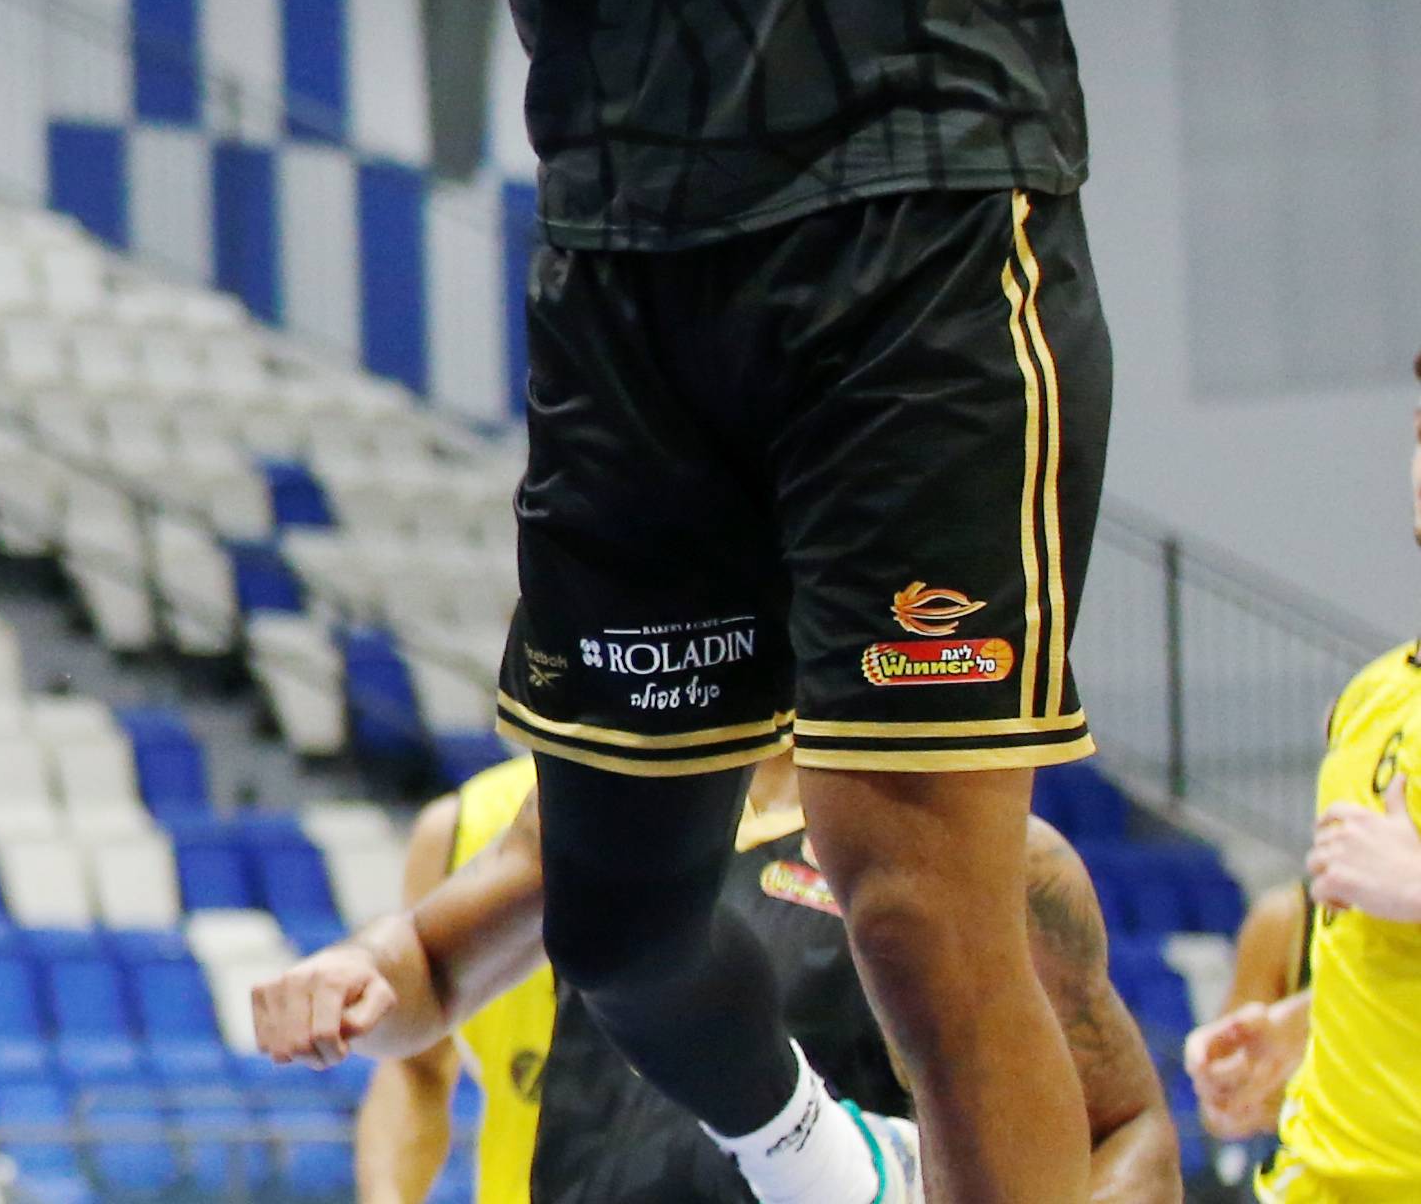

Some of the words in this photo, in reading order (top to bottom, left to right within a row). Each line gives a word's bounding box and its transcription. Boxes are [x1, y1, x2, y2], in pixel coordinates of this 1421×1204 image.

[607, 629, 755, 675] ROLADIN
[941, 644, 973, 661] ליגת
[879, 653, 976, 677] Winner
